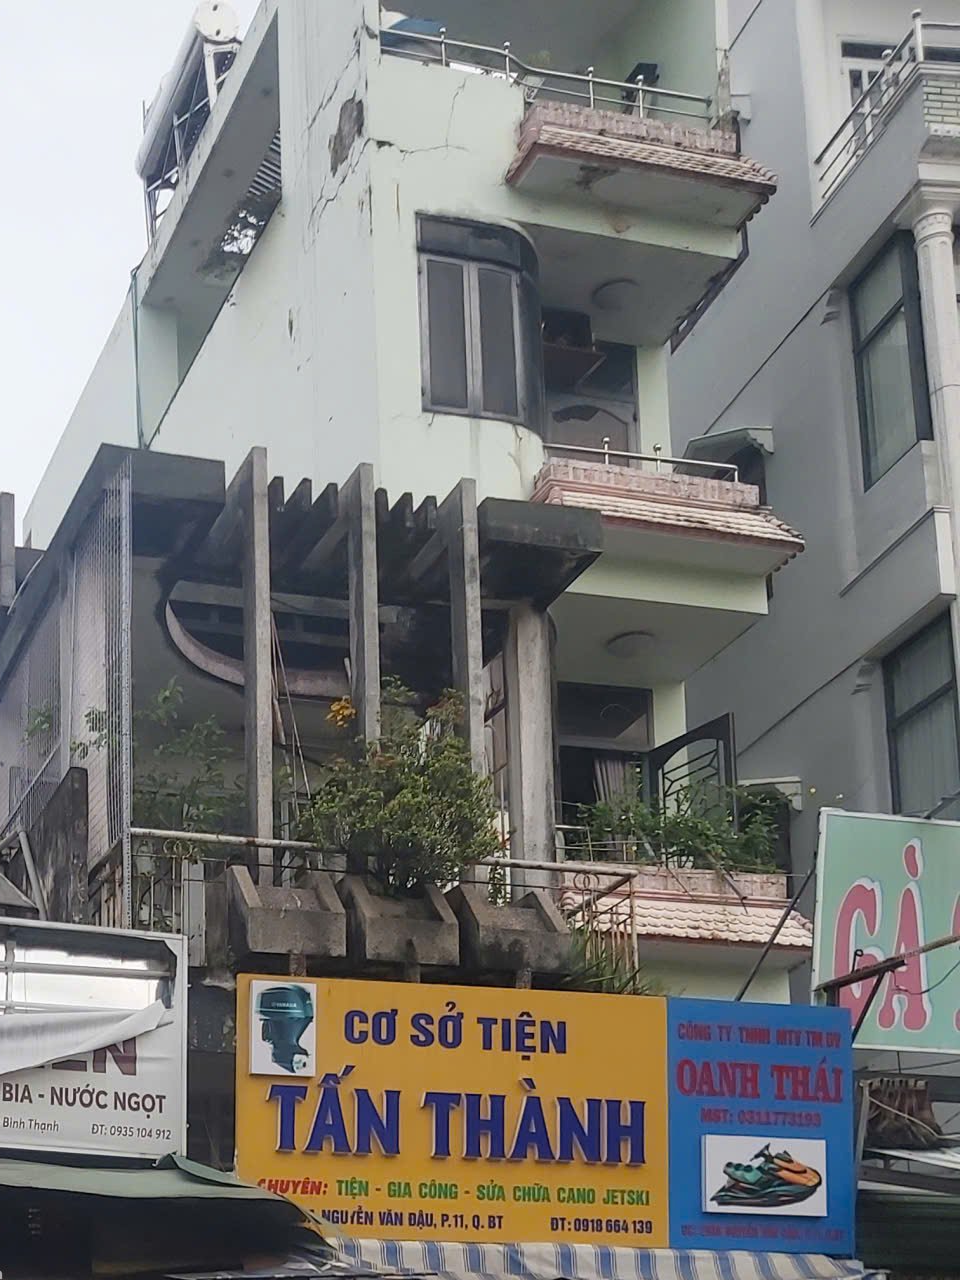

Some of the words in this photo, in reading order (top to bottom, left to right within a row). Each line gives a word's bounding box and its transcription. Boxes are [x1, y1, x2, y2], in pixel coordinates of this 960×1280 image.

[344, 1009, 398, 1046] CƠ
[410, 1001, 464, 1049] SỞ
[477, 1011, 567, 1061] TIỆN
[717, 1024, 733, 1042] TY
[676, 1057, 761, 1100] OANH
[770, 1056, 844, 1104] THÁI
[2, 1082, 33, 1104] BIA
[50, 1083, 108, 1110] NƯỚC
[113, 1093, 166, 1120] NGỌT
[266, 1064, 401, 1158] TẤN
[420, 1077, 647, 1167] THÀNH
[2, 1115, 26, 1130] Bình
[27, 1118, 60, 1134] Thạnh
[91, 1123, 107, 1136] ĐT:
[109, 1125, 134, 1137] 0935
[136, 1127, 153, 1138] 104
[155, 1128, 172, 1140] 912
[336, 1177, 369, 1200] TIỆN
[387, 1181, 412, 1199] GIA
[418, 1178, 459, 1200] CÔNG
[476, 1179, 506, 1202] SỬA
[513, 1182, 551, 1203] CHỮA
[556, 1187, 596, 1204] CANO
[602, 1189, 650, 1206] JETSKI
[378, 1209, 403, 1226] VĂN
[408, 1210, 437, 1231] ĐẬU,
[441, 1213, 469, 1230] P.11,
[472, 1214, 484, 1230] Q.
[487, 1215, 503, 1229] BT
[574, 1218, 602, 1233] 0918
[605, 1219, 628, 1233] 664
[632, 1220, 653, 1234] 139
